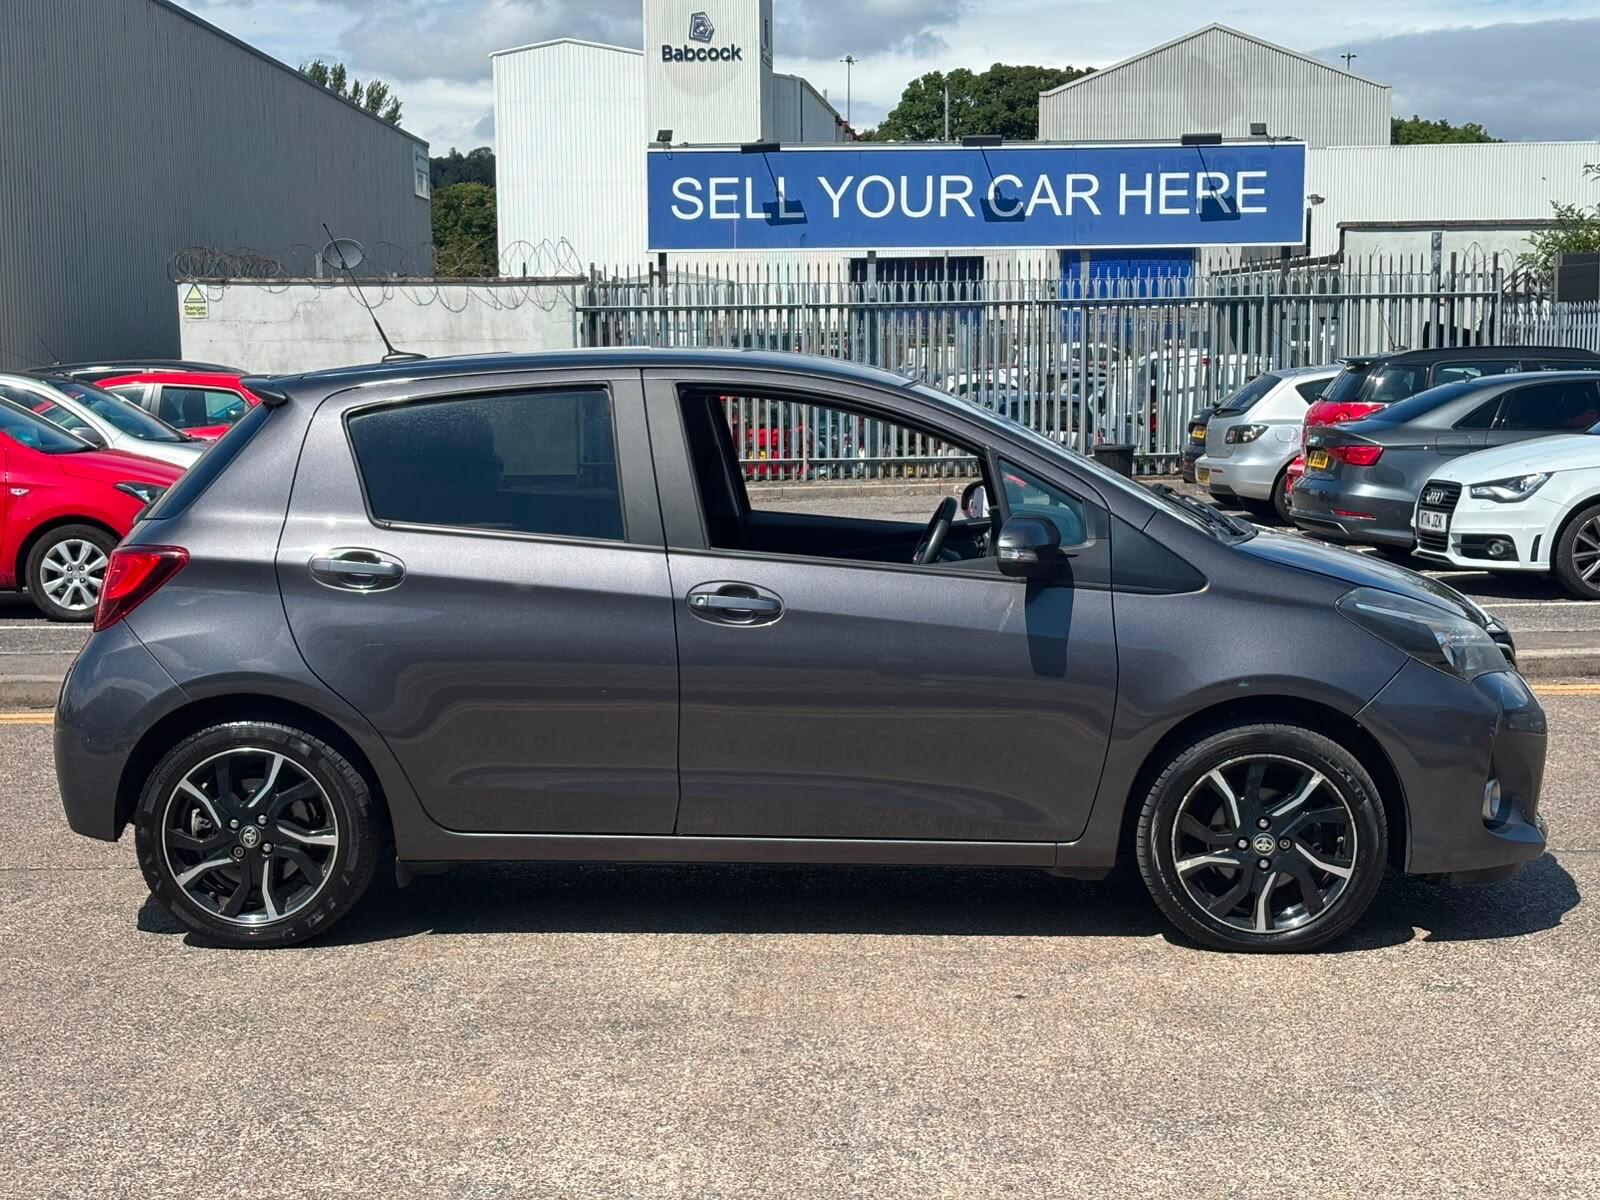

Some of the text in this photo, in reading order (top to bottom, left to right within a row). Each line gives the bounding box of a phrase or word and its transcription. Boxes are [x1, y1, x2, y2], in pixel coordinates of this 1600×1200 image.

[661, 44, 743, 62] Babcock
[671, 170, 1268, 220] SELL YOUR CAR HERE
